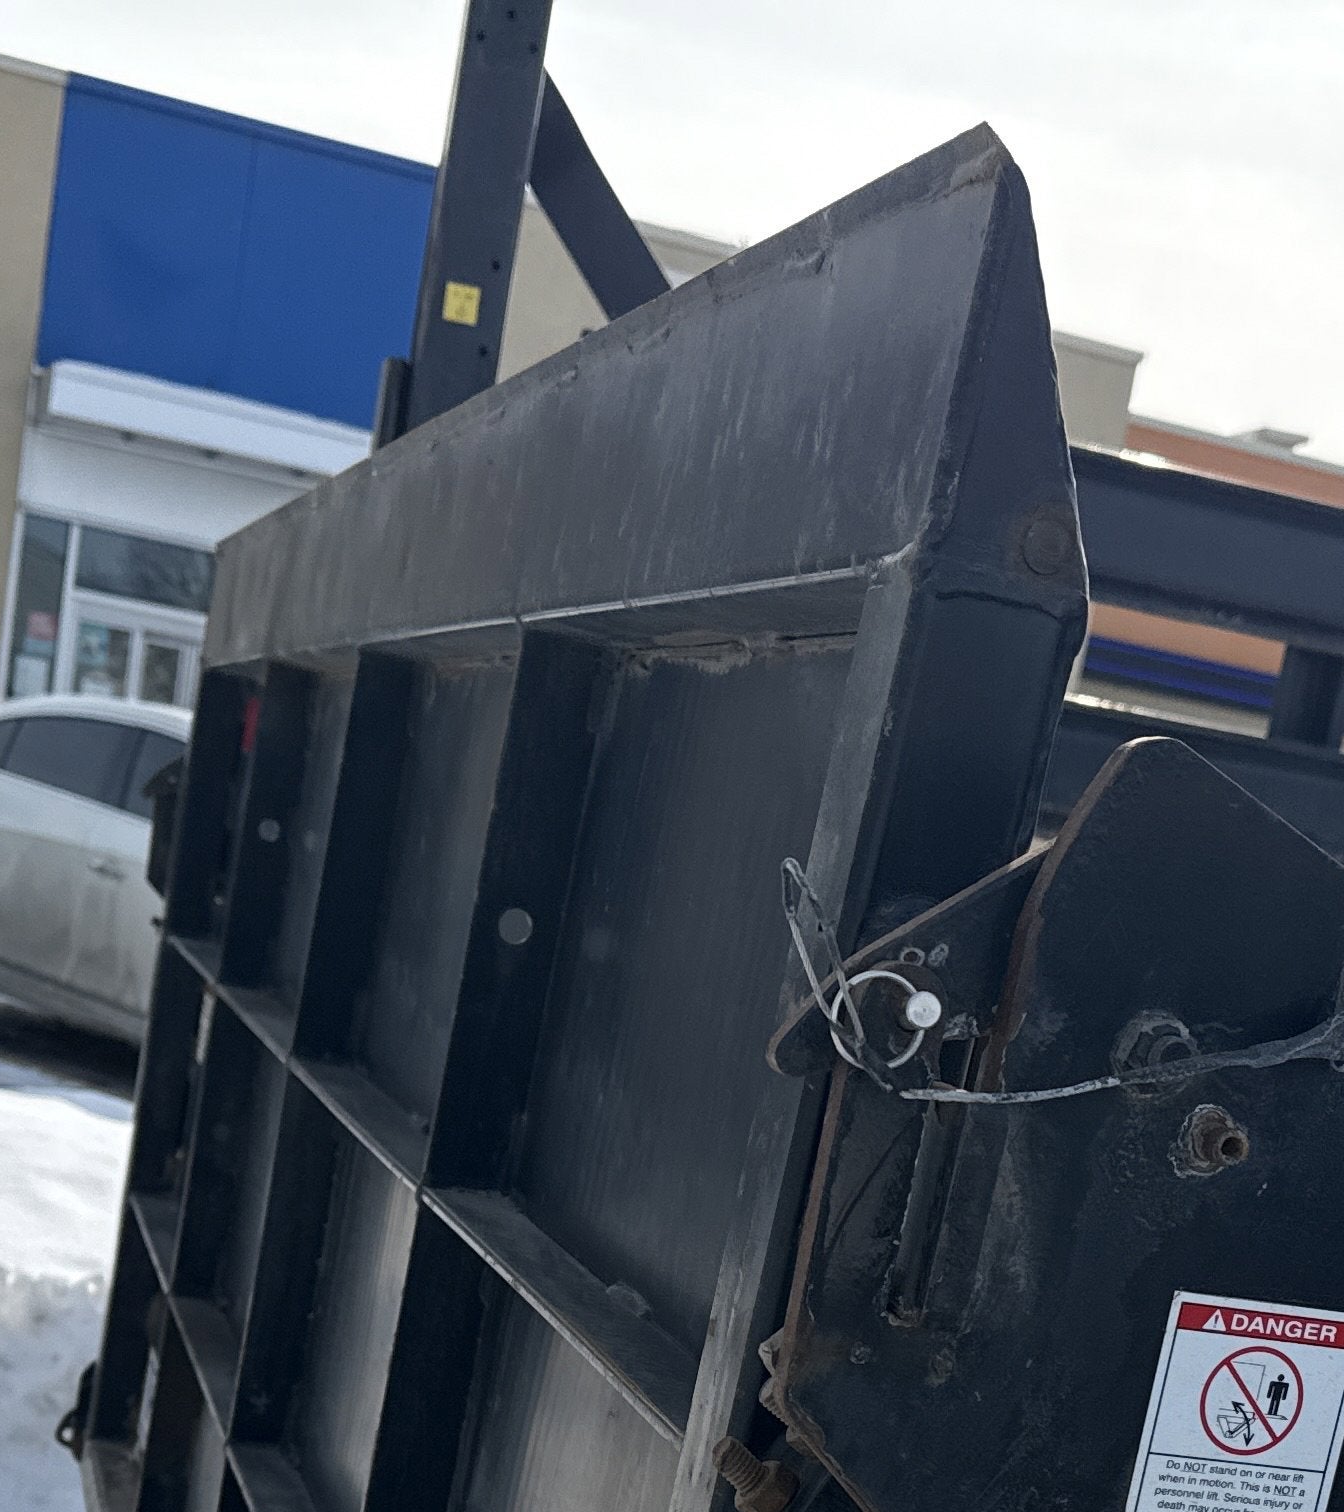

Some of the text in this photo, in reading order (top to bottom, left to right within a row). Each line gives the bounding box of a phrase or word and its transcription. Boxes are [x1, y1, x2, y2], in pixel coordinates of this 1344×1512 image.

[1230, 1313, 1337, 1342] DANGER
[1165, 1459, 1181, 1470] Do
[1182, 1461, 1207, 1473] NOT
[1208, 1465, 1237, 1476] stand
[1267, 1471, 1290, 1482] near
[1153, 1486, 1204, 1500] personnel
[1205, 1490, 1220, 1501] lift.
[1222, 1492, 1261, 1505] Serious
[1262, 1498, 1290, 1510] injury
[1198, 1477, 1236, 1489] motion.
[1238, 1480, 1260, 1492] This
[1272, 1484, 1297, 1496] NOT
[1156, 1499, 1186, 1510] death
